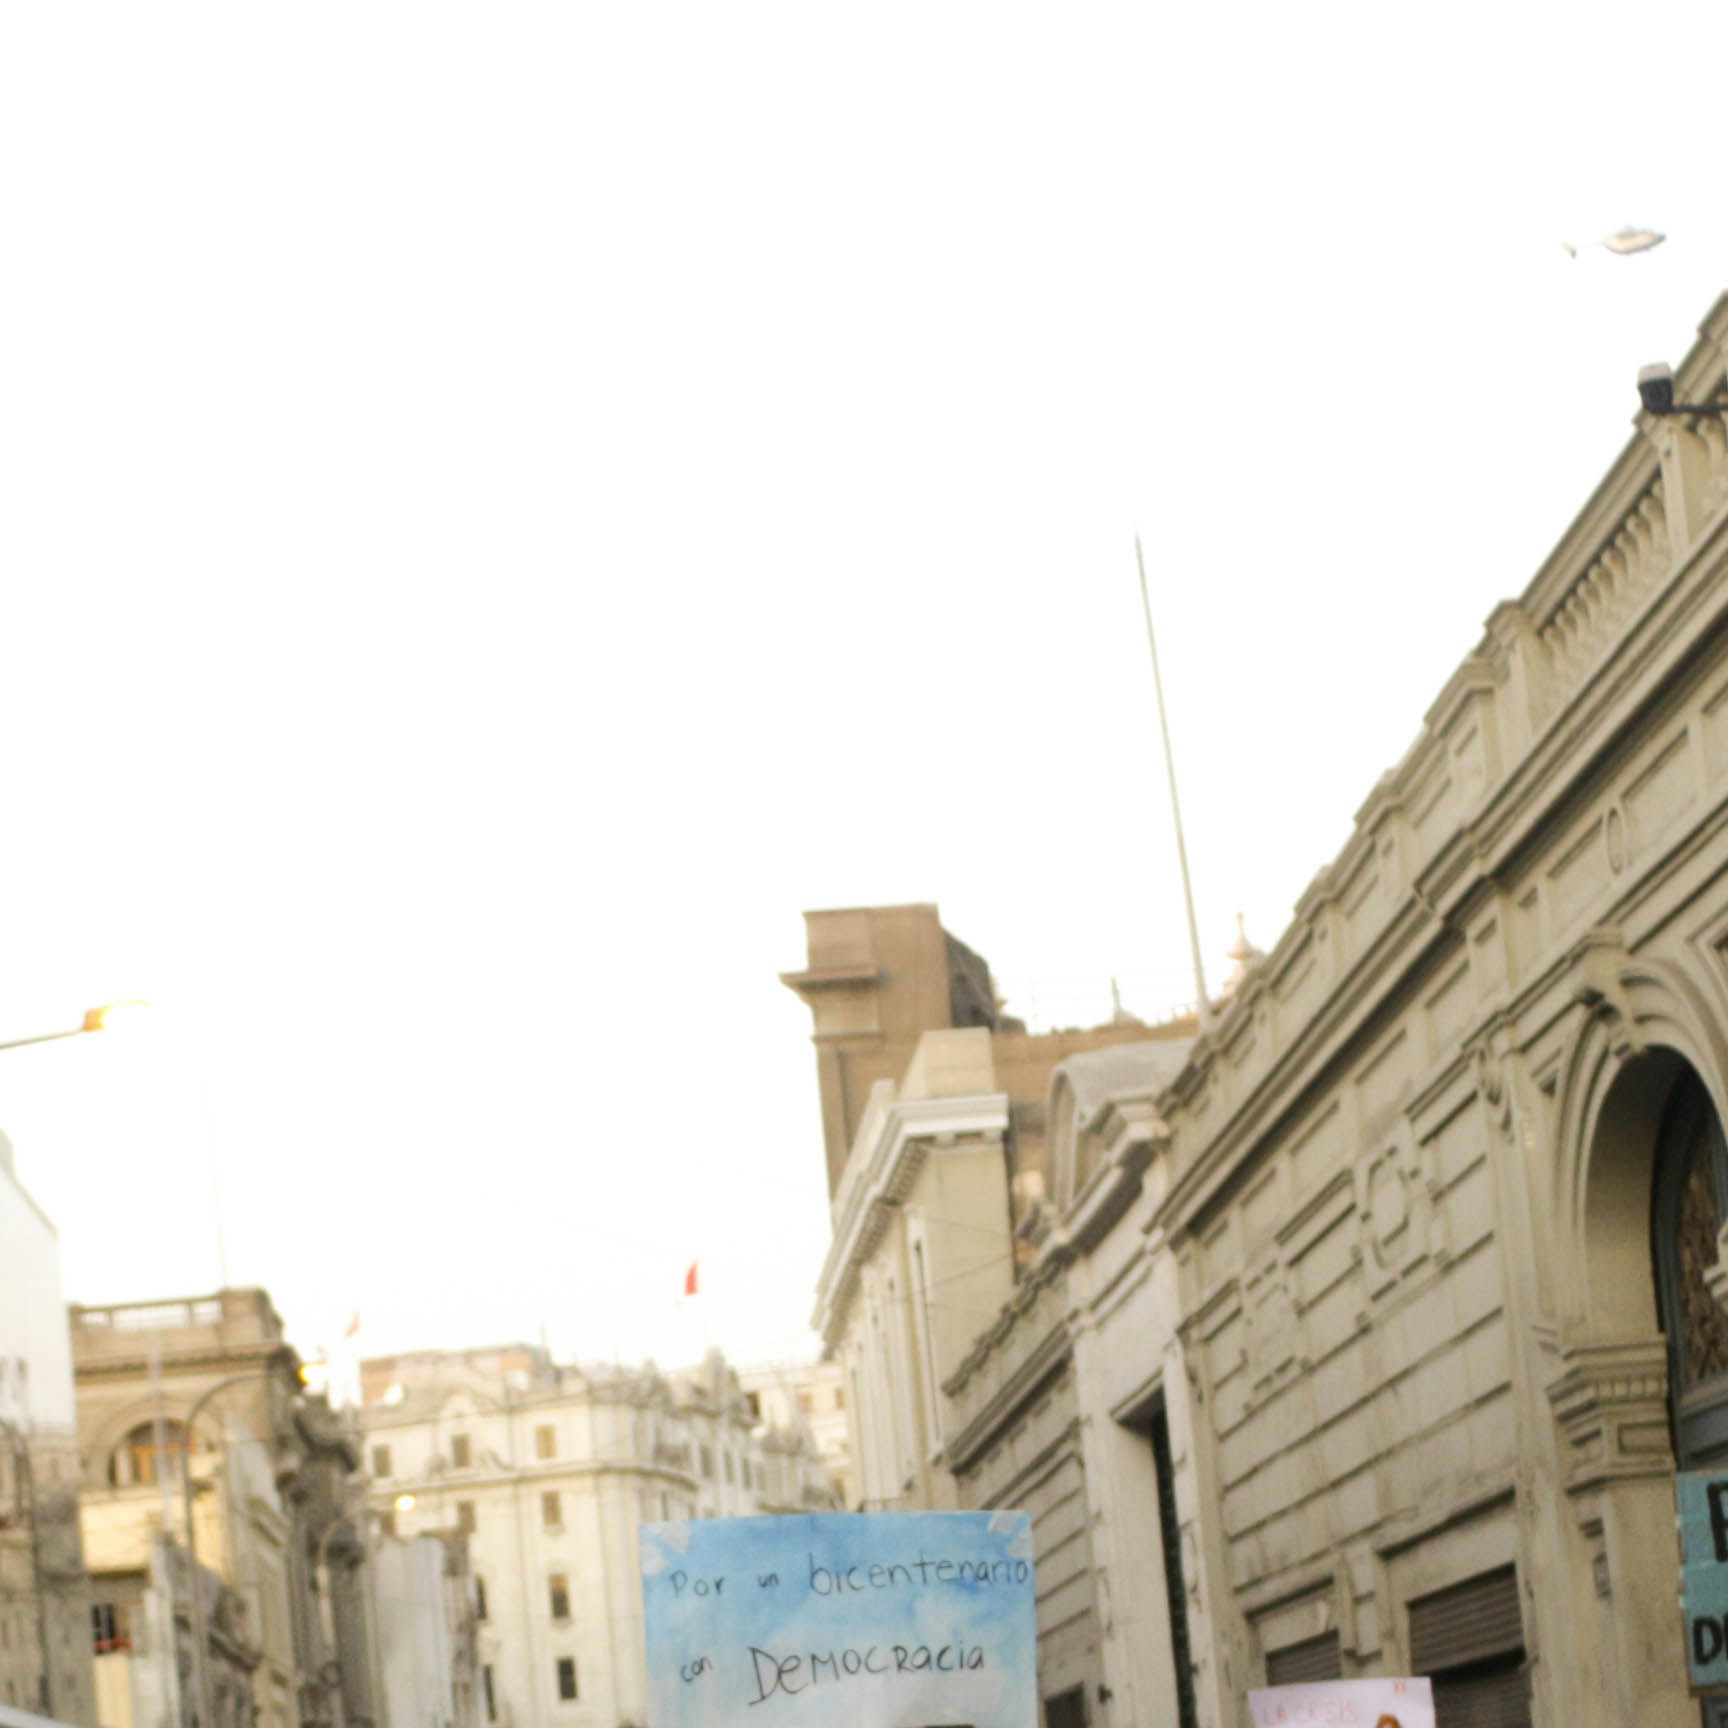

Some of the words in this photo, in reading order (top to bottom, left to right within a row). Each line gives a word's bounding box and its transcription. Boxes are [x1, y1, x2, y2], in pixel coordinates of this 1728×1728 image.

[671, 1568, 726, 1598] Por
[758, 1571, 781, 1590] un
[808, 1551, 1029, 1595] bicentenario
[680, 1656, 712, 1684] con
